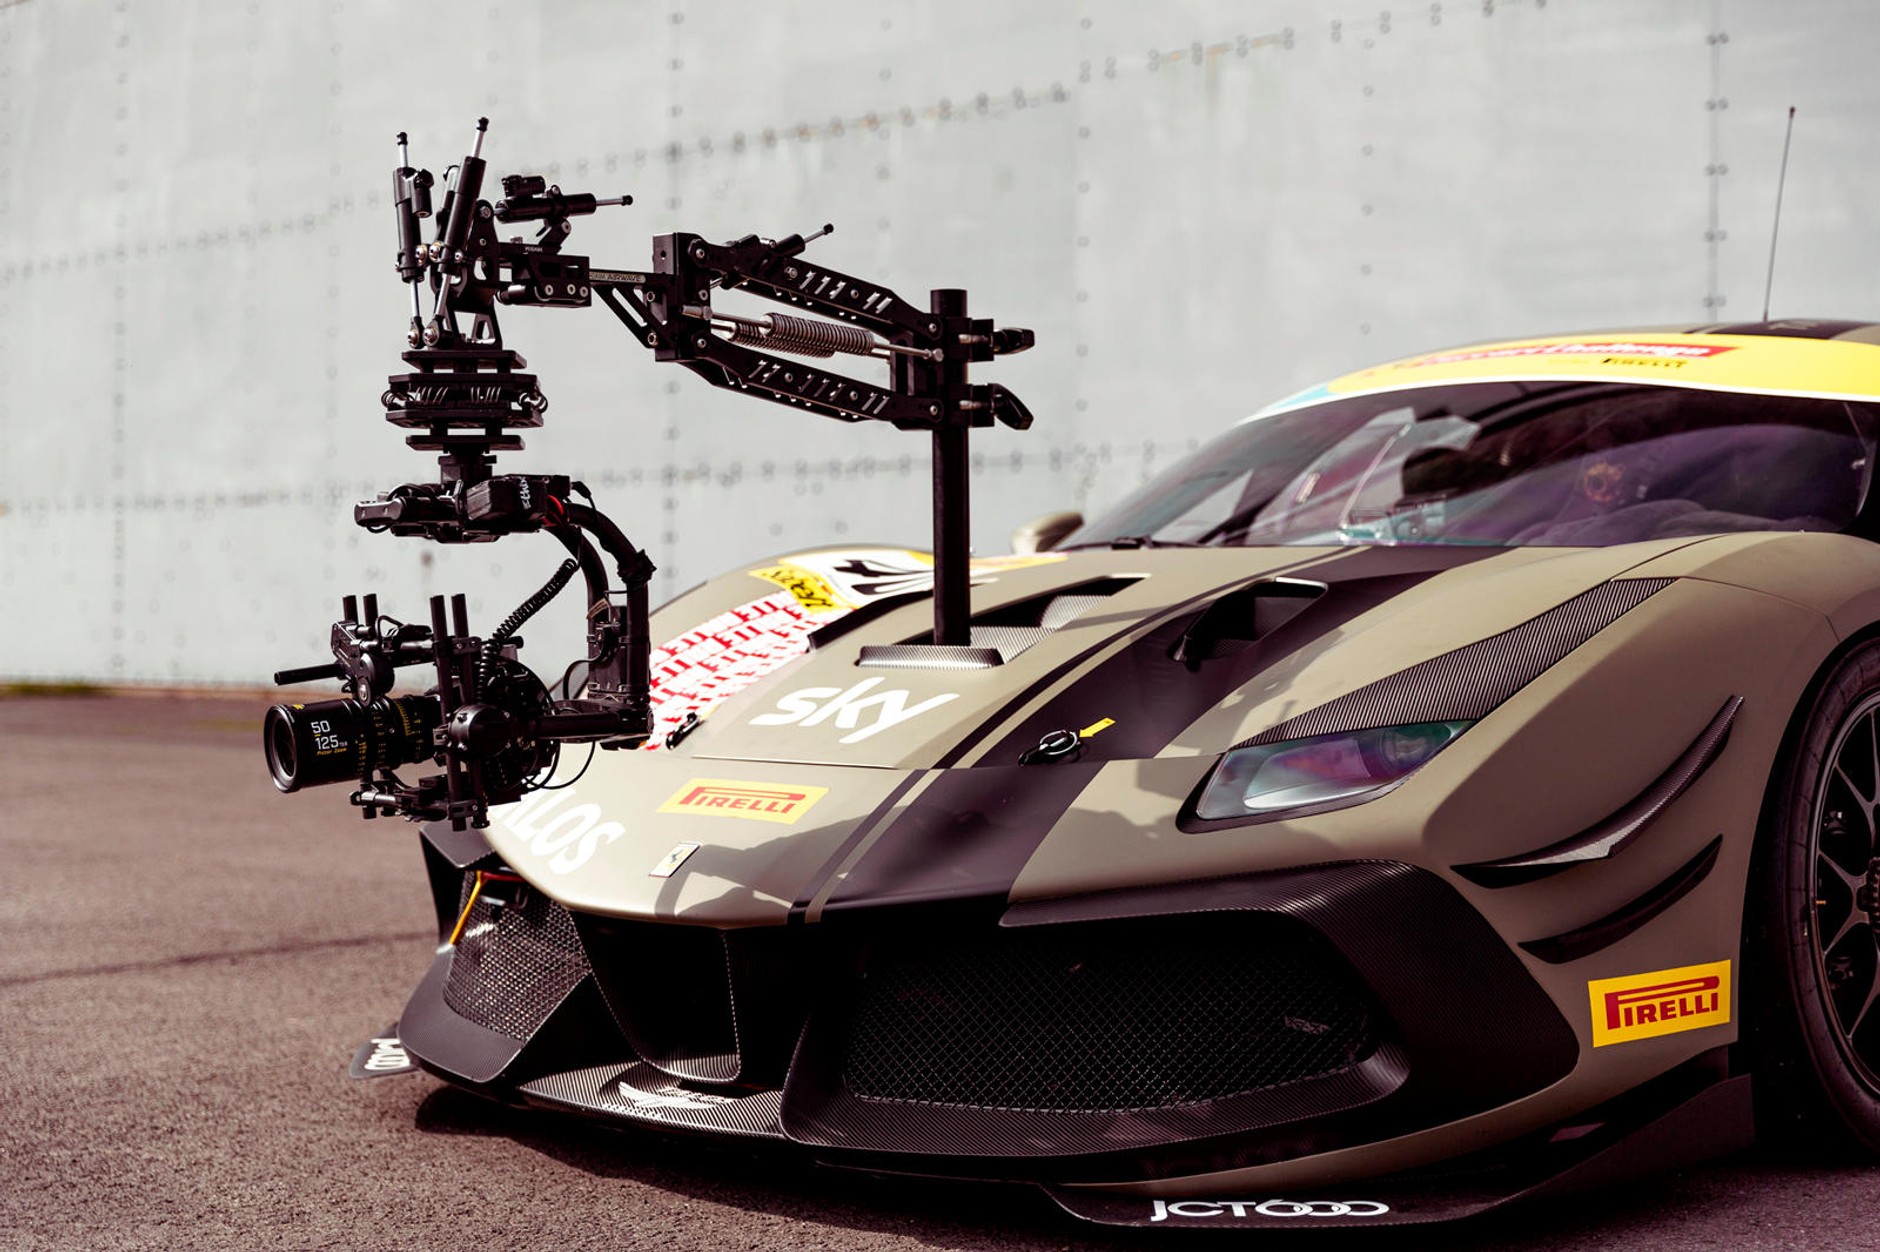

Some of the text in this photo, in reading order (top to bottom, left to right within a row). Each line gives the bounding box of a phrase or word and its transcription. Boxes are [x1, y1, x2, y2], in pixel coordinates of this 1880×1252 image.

[748, 676, 960, 744] sky
[310, 720, 331, 733] 50
[314, 734, 339, 750] 125
[678, 786, 806, 814] PIRELLI
[1604, 975, 1720, 1030] PIRELLI
[1150, 1199, 1390, 1222] JCT600
